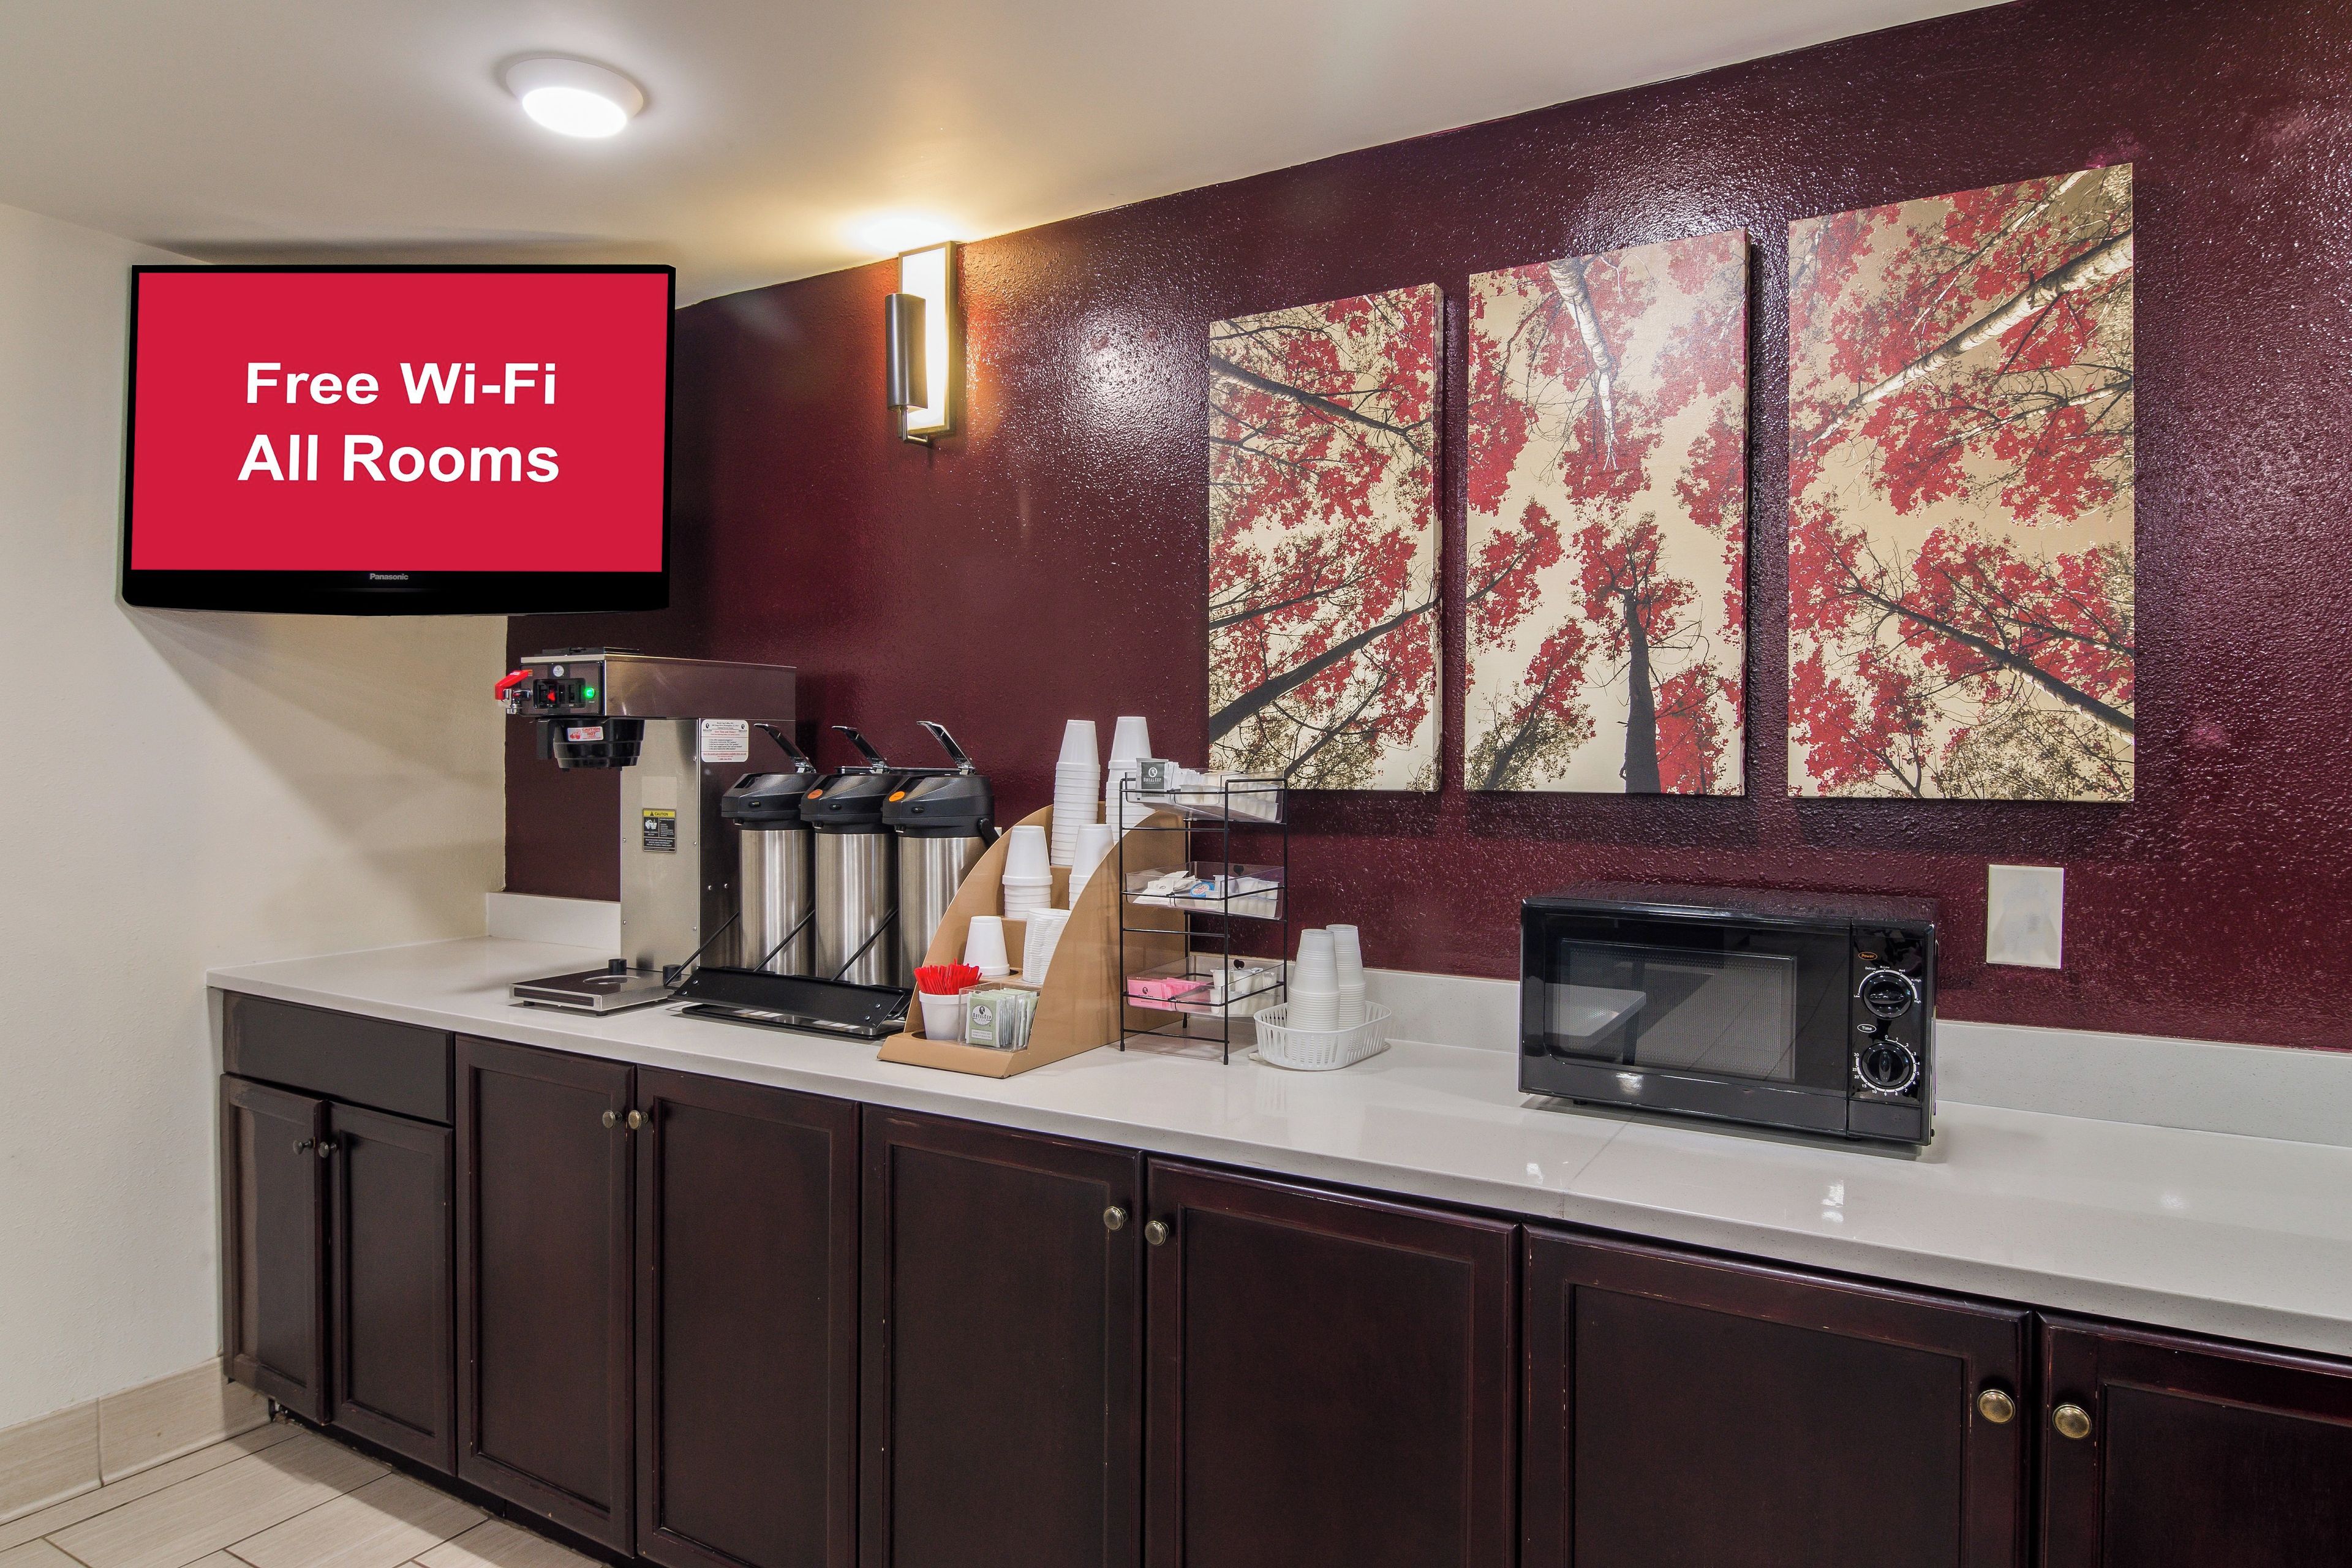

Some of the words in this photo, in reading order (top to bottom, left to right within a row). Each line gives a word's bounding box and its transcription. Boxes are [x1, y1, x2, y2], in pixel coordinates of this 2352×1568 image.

[247, 363, 379, 404] Free
[400, 363, 556, 404] Wi-Fi
[238, 434, 318, 481] All
[344, 434, 559, 482] Rooms
